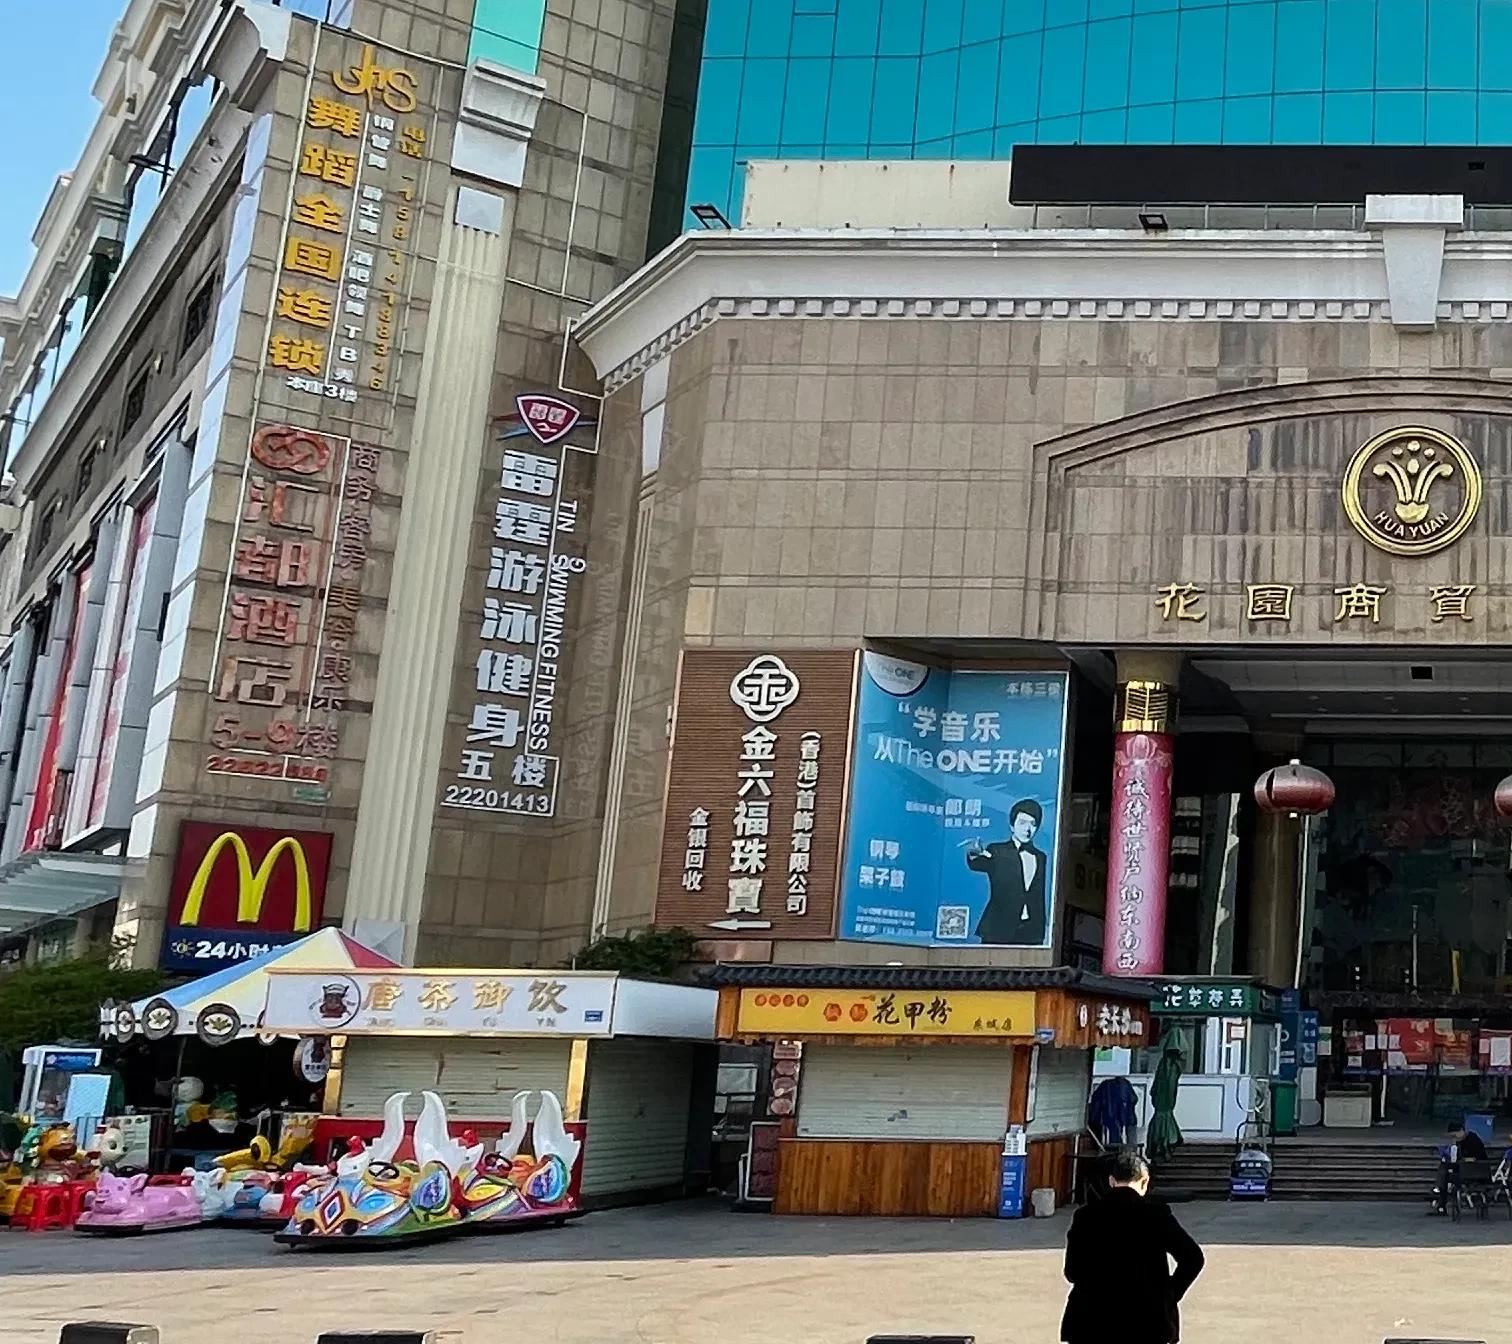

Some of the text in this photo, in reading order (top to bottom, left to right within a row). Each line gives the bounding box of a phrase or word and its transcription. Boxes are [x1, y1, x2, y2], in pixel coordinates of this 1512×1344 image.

[269, 97, 361, 375] 舞蹈全国连锁
[1375, 511, 1450, 538] HUA YUAN
[216, 477, 319, 706] 汇都酒店
[467, 449, 558, 748] 雷霆游泳健身
[541, 554, 569, 658] SWIMMING
[530, 662, 558, 751] FITNESS
[445, 786, 550, 814] 22201413
[457, 749, 549, 788] 五楼
[726, 725, 778, 914] 金六福珠寶
[363, 977, 569, 1015] 唐茶御饮
[872, 994, 954, 1031] 花甲粉
